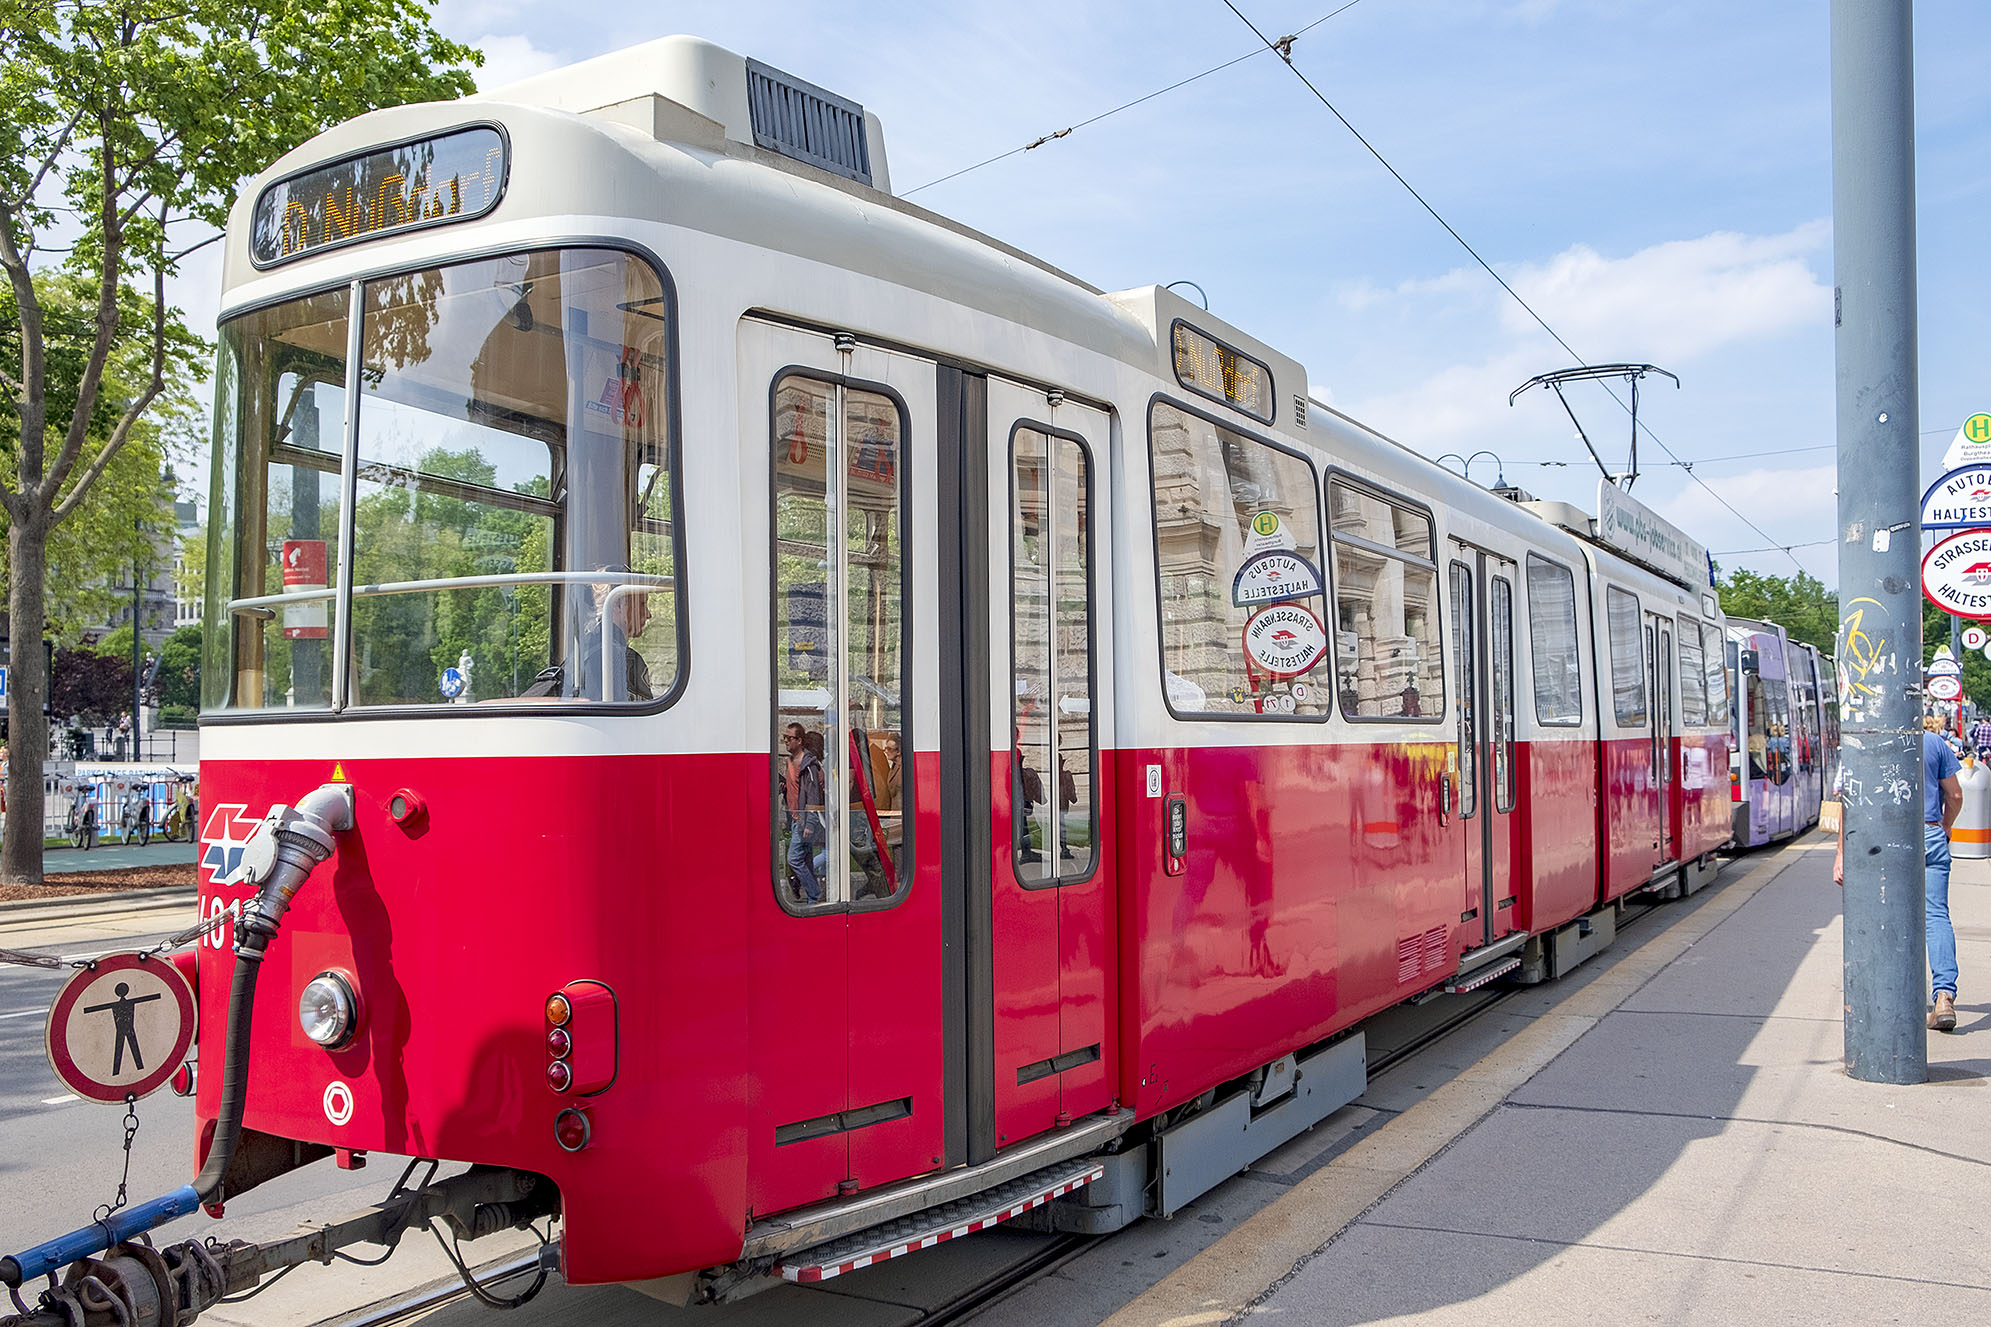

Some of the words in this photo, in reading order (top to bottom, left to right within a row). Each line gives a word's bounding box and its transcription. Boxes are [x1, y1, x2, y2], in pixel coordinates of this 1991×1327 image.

[1972, 419, 1990, 438] H
[1934, 539, 1991, 570] STRASSE
[1968, 633, 1980, 644] D
